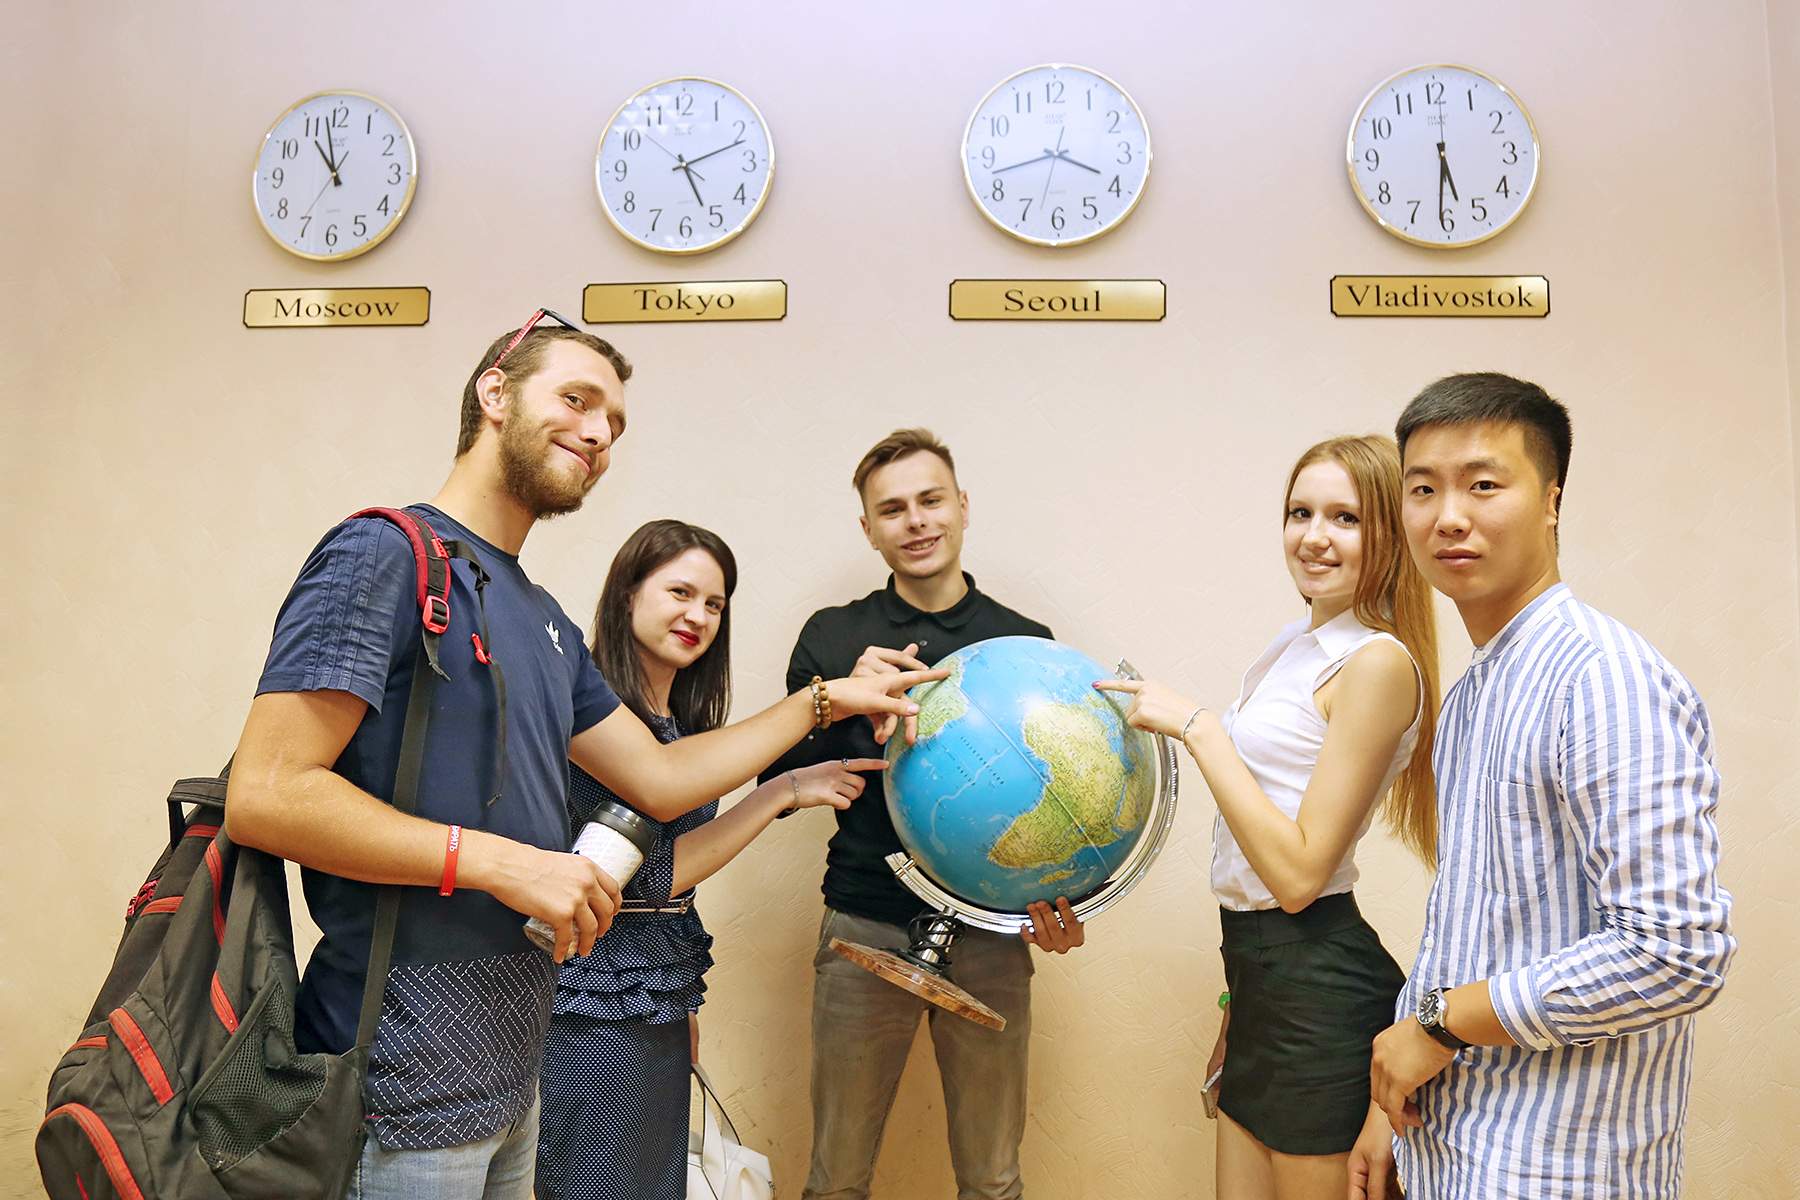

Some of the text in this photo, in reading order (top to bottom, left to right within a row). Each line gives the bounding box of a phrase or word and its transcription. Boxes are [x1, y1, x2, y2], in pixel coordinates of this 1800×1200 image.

[1015, 91, 1032, 114] 11
[1045, 80, 1066, 104] 12
[1085, 88, 1091, 111] 1
[1395, 92, 1413, 115] 11
[1425, 81, 1446, 106] 12
[1466, 88, 1474, 112] 1
[647, 105, 662, 127] 11
[675, 93, 694, 116] 12
[713, 100, 719, 122] 1
[305, 116, 320, 137] 11
[332, 106, 349, 128] 12
[365, 114, 372, 135] 1
[990, 114, 1009, 138] 10
[1106, 110, 1121, 134] 2
[1372, 116, 1392, 140] 10
[1489, 110, 1505, 135] 2
[623, 128, 641, 151] 10
[732, 120, 746, 145] 2
[282, 138, 299, 160] 10
[382, 134, 395, 156] 2
[1116, 140, 1132, 165] 3
[1502, 141, 1518, 166] 3
[741, 150, 757, 173] 3
[982, 145, 996, 169] 9
[1365, 148, 1380, 172] 9
[272, 167, 284, 189] 9
[387, 162, 402, 185] 3
[614, 159, 627, 182] 9
[732, 182, 746, 205] 4
[992, 178, 1004, 202] 8
[1107, 175, 1122, 198] 4
[1378, 180, 1391, 205] 8
[1495, 175, 1510, 199] 4
[277, 197, 288, 220] 8
[376, 194, 389, 217] 4
[623, 190, 635, 213] 8
[1019, 198, 1033, 222] 7
[1082, 196, 1098, 220] 5
[1406, 200, 1421, 224] 7
[1471, 197, 1488, 222] 5
[300, 215, 312, 238] 7
[352, 215, 367, 237] 5
[649, 208, 663, 232] 7
[679, 216, 693, 239] 6
[708, 205, 723, 228] 5
[1051, 206, 1065, 231] 6
[1440, 208, 1455, 233] 6
[325, 223, 338, 246] 6
[633, 288, 735, 316] Tokyo
[1004, 288, 1102, 313] Seoul
[1346, 284, 1536, 308] Vladivostok
[273, 297, 400, 319] Moscow
